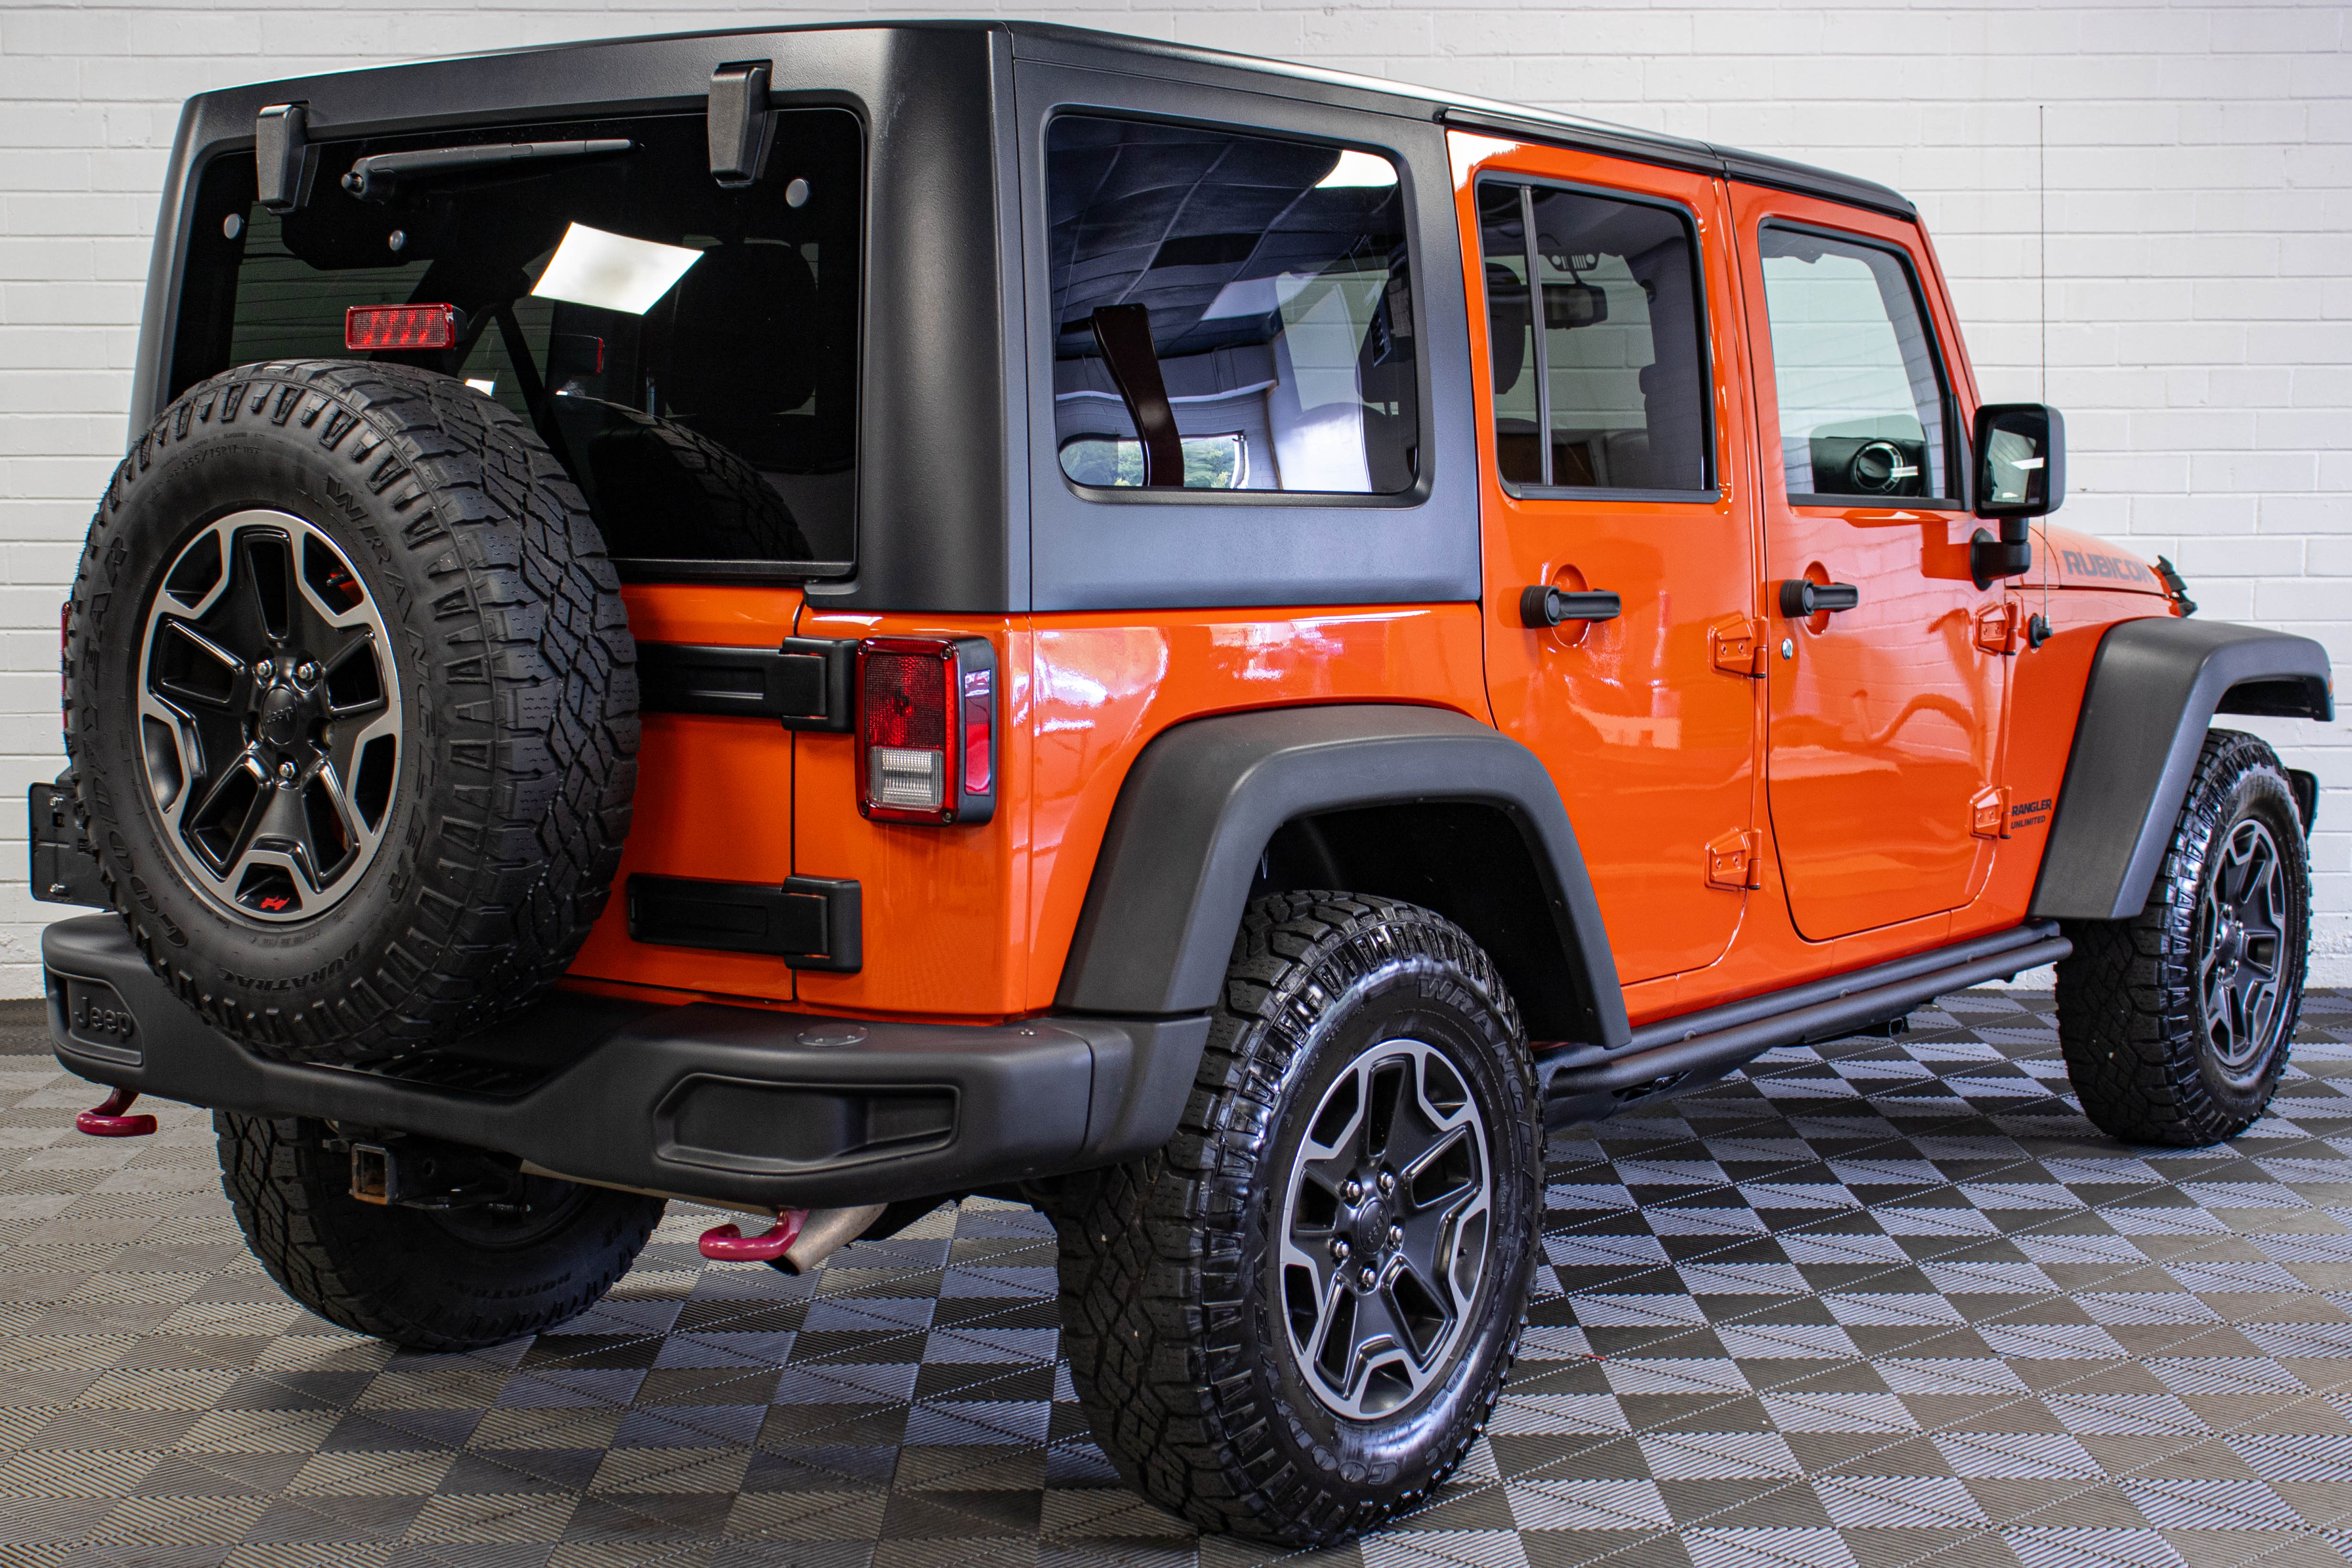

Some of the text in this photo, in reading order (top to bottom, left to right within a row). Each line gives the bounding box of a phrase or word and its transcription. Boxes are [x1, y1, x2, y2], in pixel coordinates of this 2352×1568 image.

[2061, 550, 2155, 584] RUBICON
[324, 473, 436, 903] WRANGLER
[81, 536, 188, 947] GOODYEAR
[2011, 815, 2046, 829] UNLIMITED
[2012, 799, 2052, 817] RANGLER
[218, 941, 360, 992] DURATRAC
[74, 996, 135, 1042] Jeep
[1418, 975, 1535, 1259] WRANGLER
[1256, 1186, 1399, 1485] GOODYEAR
[1425, 1313, 1514, 1466] DURATRAC
